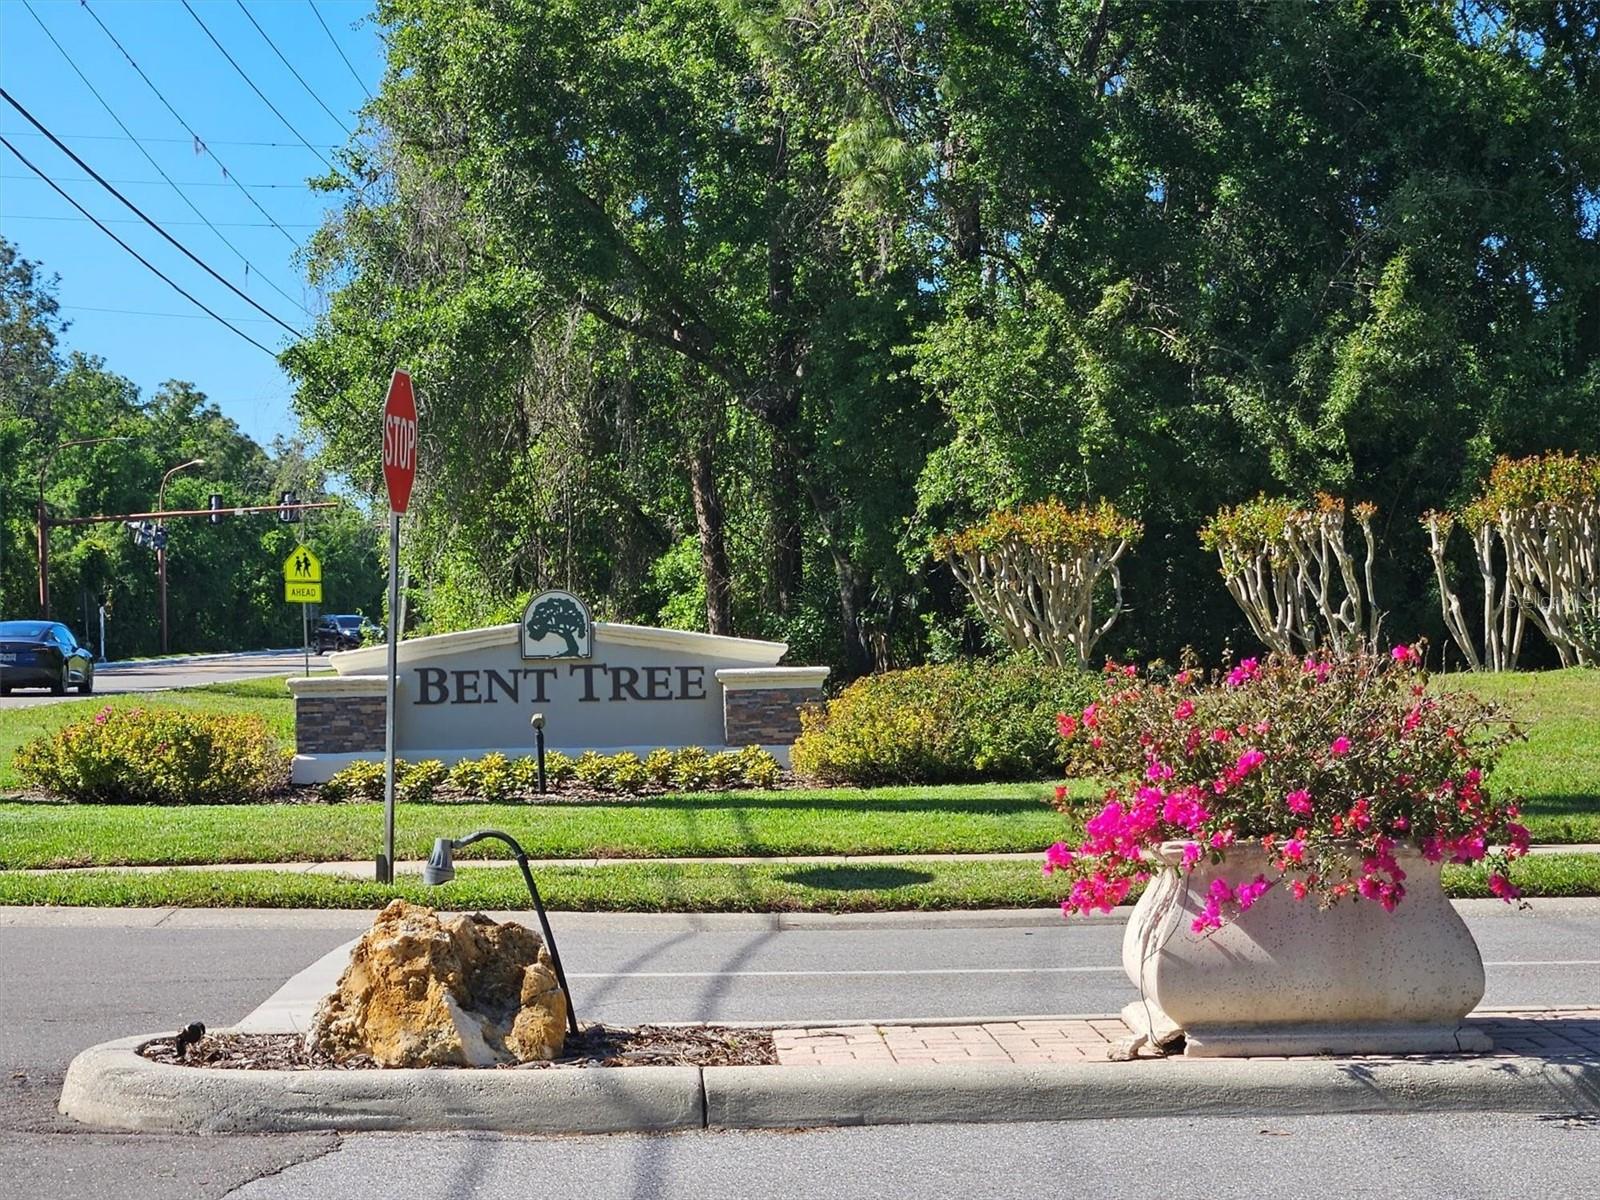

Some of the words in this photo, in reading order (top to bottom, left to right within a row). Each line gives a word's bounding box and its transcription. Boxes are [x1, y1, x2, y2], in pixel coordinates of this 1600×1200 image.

[385, 414, 415, 470] STOP
[291, 588, 316, 597] AHEAD
[413, 667, 558, 705] BENT
[569, 663, 707, 703] TREE
